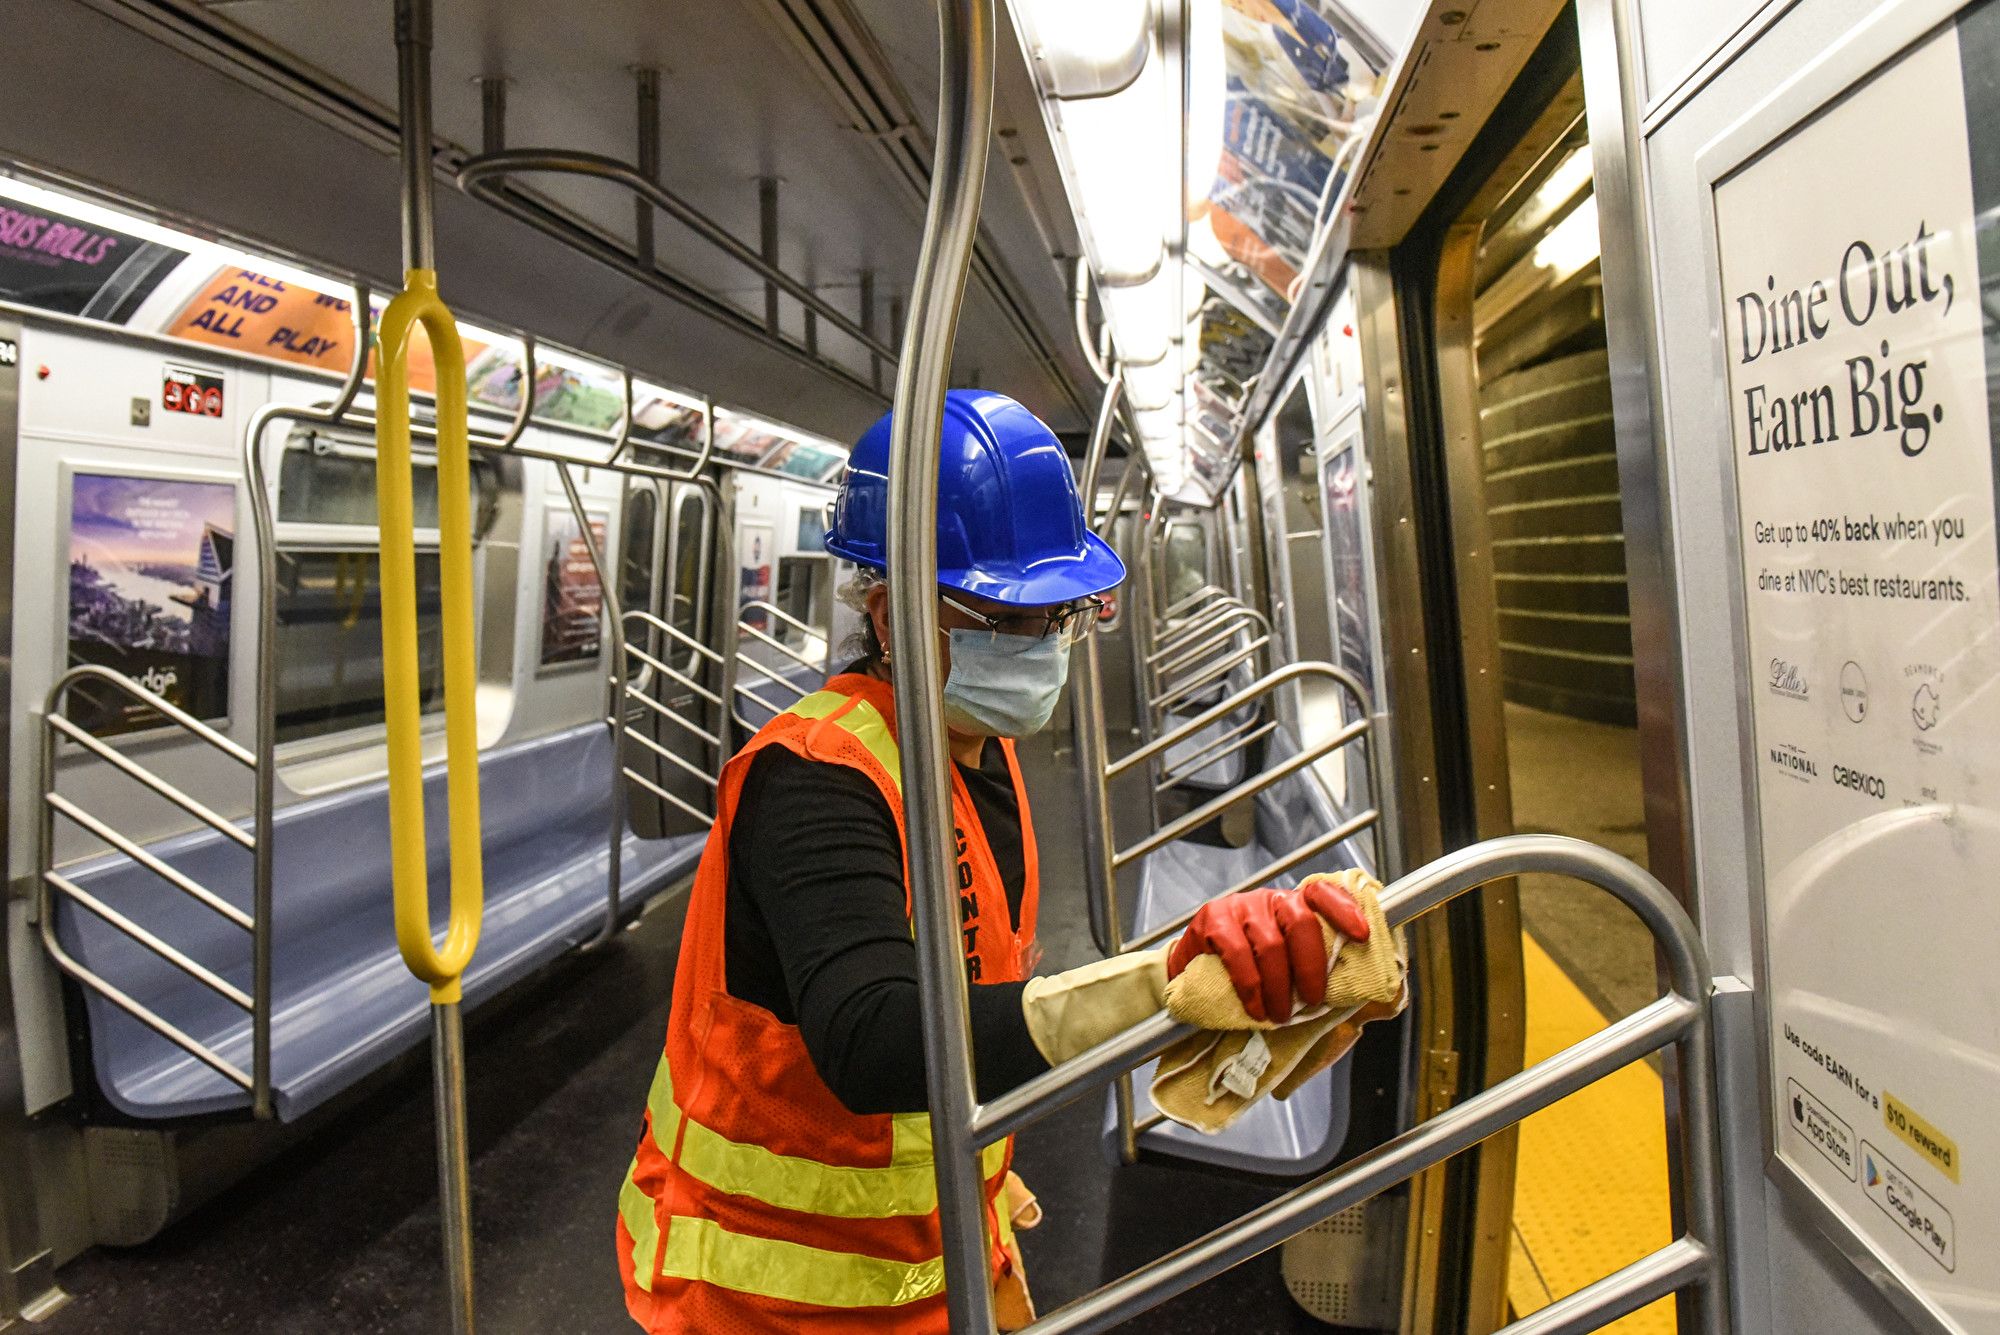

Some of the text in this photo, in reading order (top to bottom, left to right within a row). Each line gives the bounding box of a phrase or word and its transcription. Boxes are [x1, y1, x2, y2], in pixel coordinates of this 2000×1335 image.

[34, 222, 118, 265] ROLLS
[212, 286, 278, 314] AND
[1736, 219, 1954, 364] Dine Out,
[189, 309, 244, 338] ALL
[267, 327, 337, 357] PLAY
[1744, 339, 1943, 457] Earn Big.
[1755, 512, 1965, 548] Get up to 40% back when you
[1758, 568, 1970, 602] dine at NYC's best restaurants.
[1770, 749, 1818, 777] NATIONAL
[1832, 764, 1886, 800] calexico
[1784, 1023, 1952, 1168] Use code EARN for a $10 reward
[1806, 1114, 1851, 1167] App Store
[1886, 1185, 1946, 1256] Google Play
